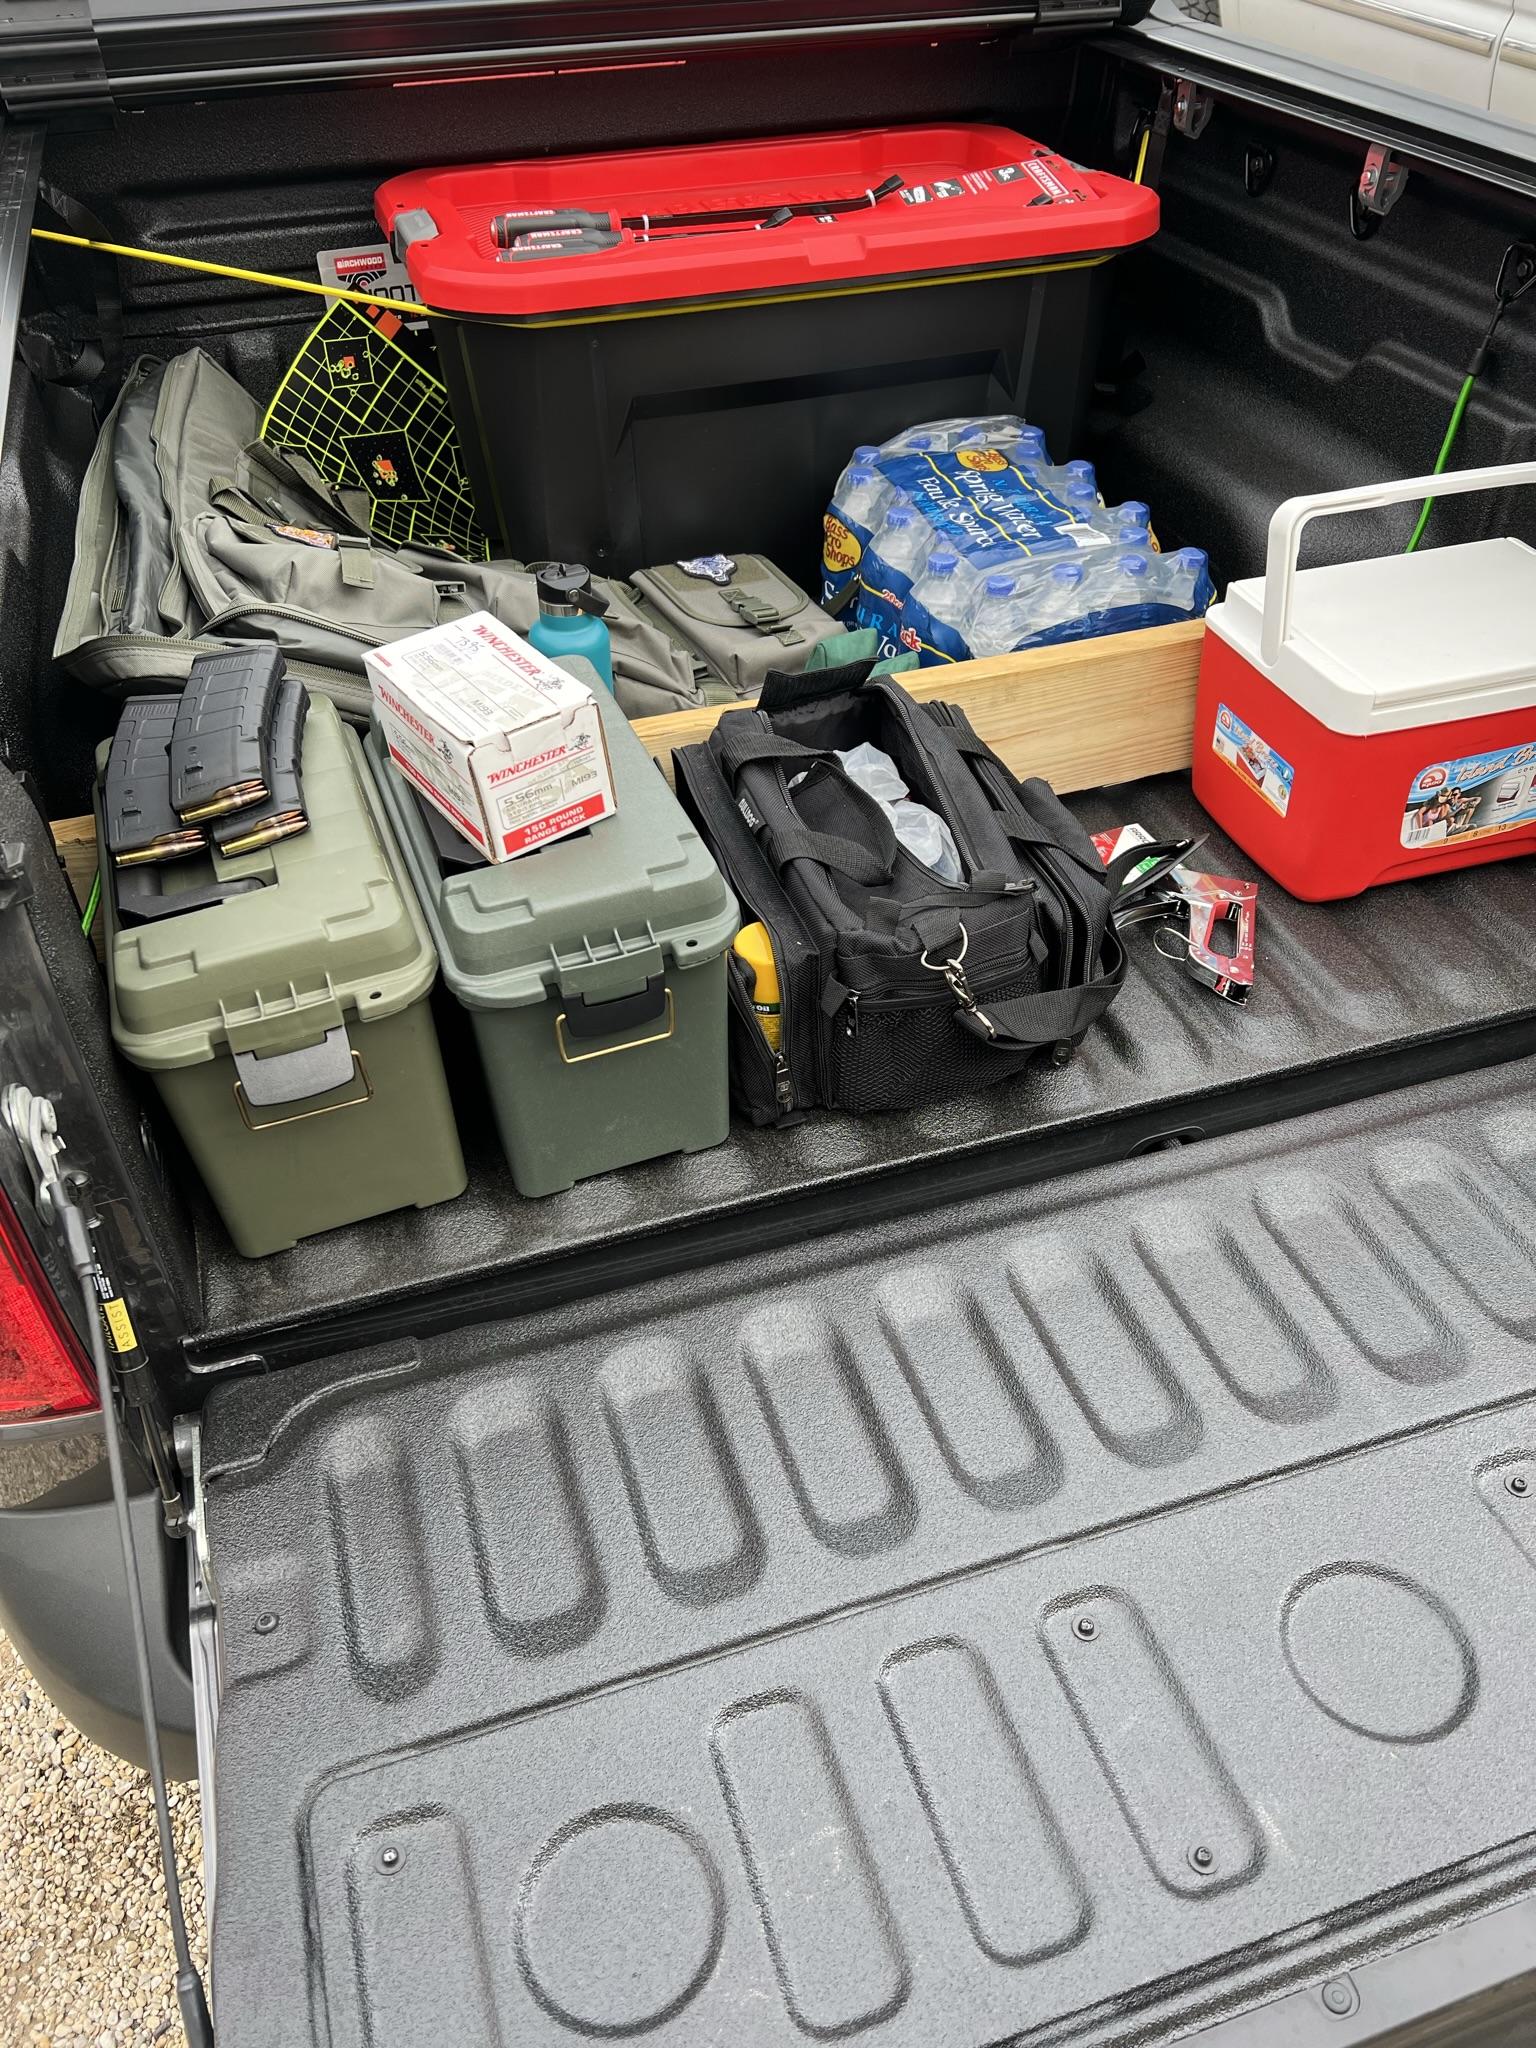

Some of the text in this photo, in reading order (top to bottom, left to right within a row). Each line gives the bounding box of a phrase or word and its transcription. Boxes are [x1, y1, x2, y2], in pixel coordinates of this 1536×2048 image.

[1026, 161, 1062, 195] CRAFTSMAN
[530, 228, 583, 238] CRAFTSMAN
[917, 476, 945, 501] Eau
[826, 515, 848, 540] Bass
[825, 543, 856, 568] Shops
[472, 624, 542, 677] WINCHESTER
[378, 684, 435, 746] WINCHESTER
[487, 744, 567, 785] WINCHESTER
[571, 770, 598, 788] M193
[1457, 753, 1513, 782] Island
[523, 821, 547, 836] 150
[548, 806, 584, 826] ROUND
[523, 826, 559, 845] RANGE
[560, 813, 587, 830] PACK
[108, 1304, 132, 1348] ASSIST
